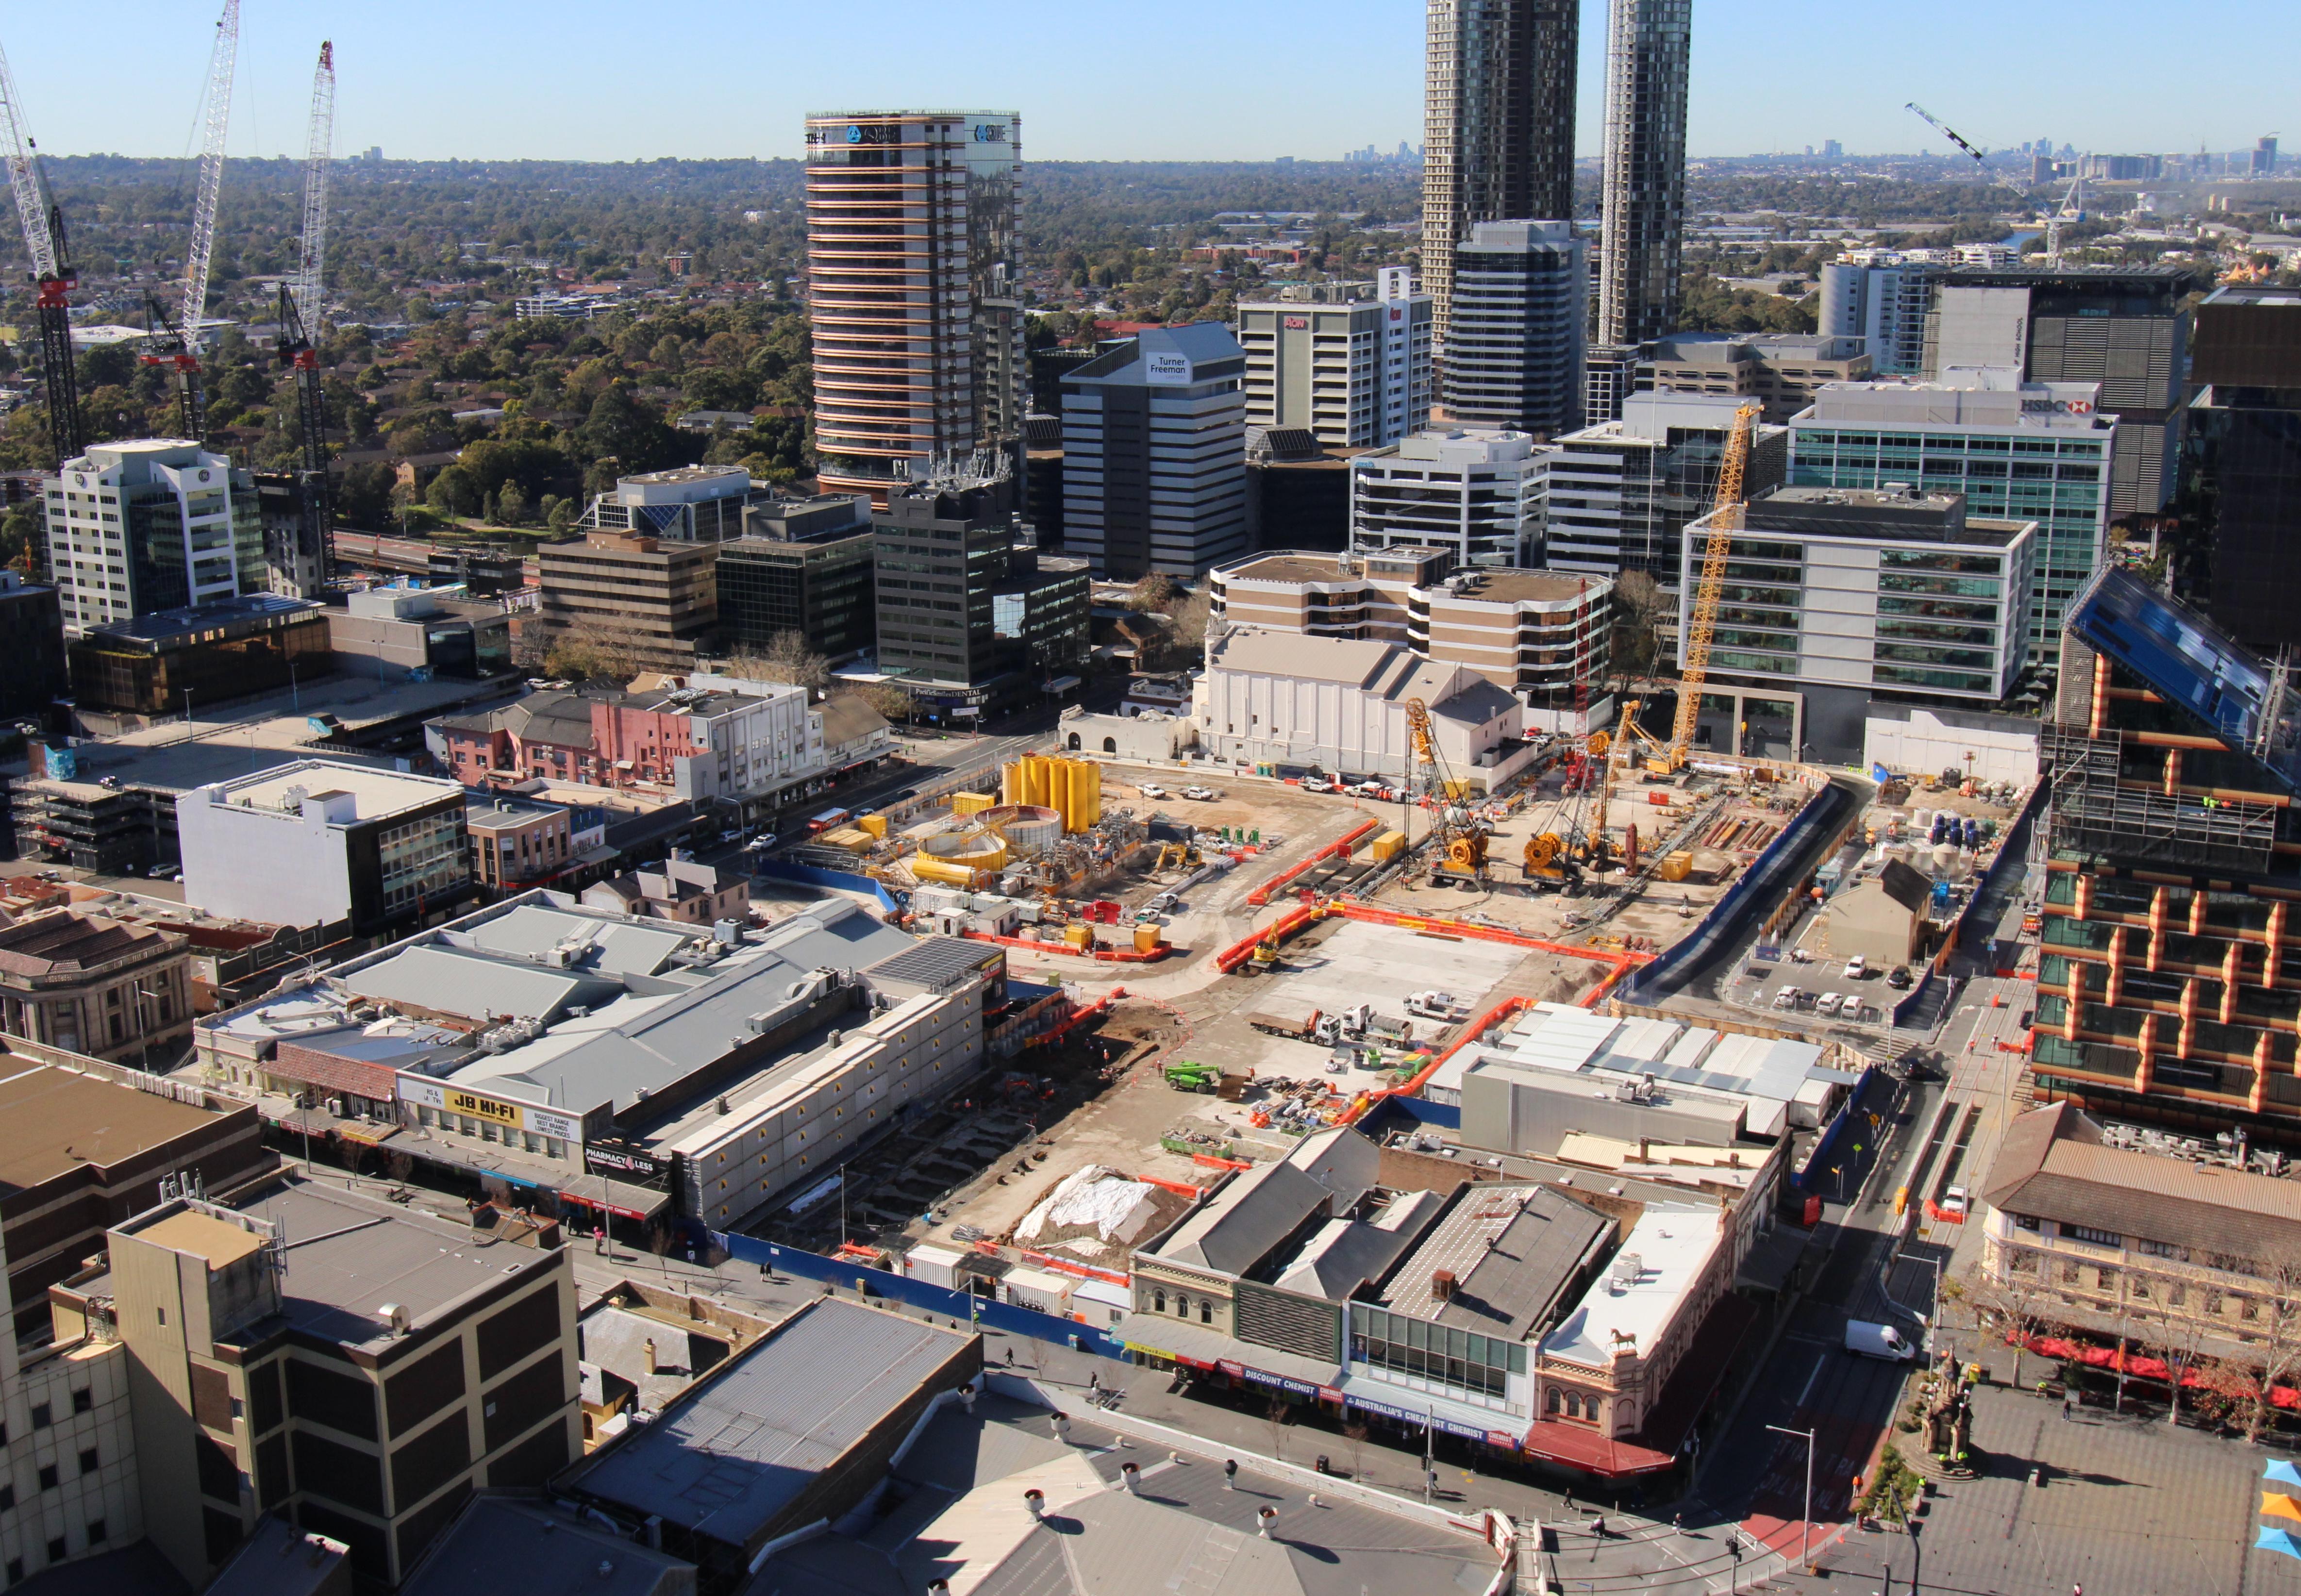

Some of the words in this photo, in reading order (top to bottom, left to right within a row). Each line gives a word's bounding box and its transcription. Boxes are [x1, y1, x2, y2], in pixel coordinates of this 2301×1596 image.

[864, 125, 897, 142] QBE
[1159, 357, 1185, 366] Turner
[1151, 365, 1185, 373] Freeman
[2020, 399, 2069, 413] HSBC
[952, 689, 981, 697] DENTAL
[1383, 1028, 1401, 1036] WARD
[454, 1094, 476, 1110] JB
[534, 1113, 553, 1122] BIGGEST
[554, 1117, 570, 1126] RANGE
[535, 1125, 552, 1134] LOWEST
[554, 1130, 570, 1139] PRICES
[549, 1122, 568, 1132] BRANDS
[586, 1148, 626, 1164] PHARMACY
[625, 1156, 635, 1170] 4
[635, 1160, 653, 1171] LESS
[1220, 1361, 1241, 1372] CHEMIST
[1246, 1370, 1282, 1385] DISCOUNT
[1284, 1380, 1315, 1394] CHEMIST
[1320, 1387, 1342, 1398] CHEMIST
[1354, 1398, 1402, 1417] AUSTRALIA'S
[1448, 1423, 1483, 1439] CHEMIST
[1488, 1432, 1513, 1443] CHEMIST
